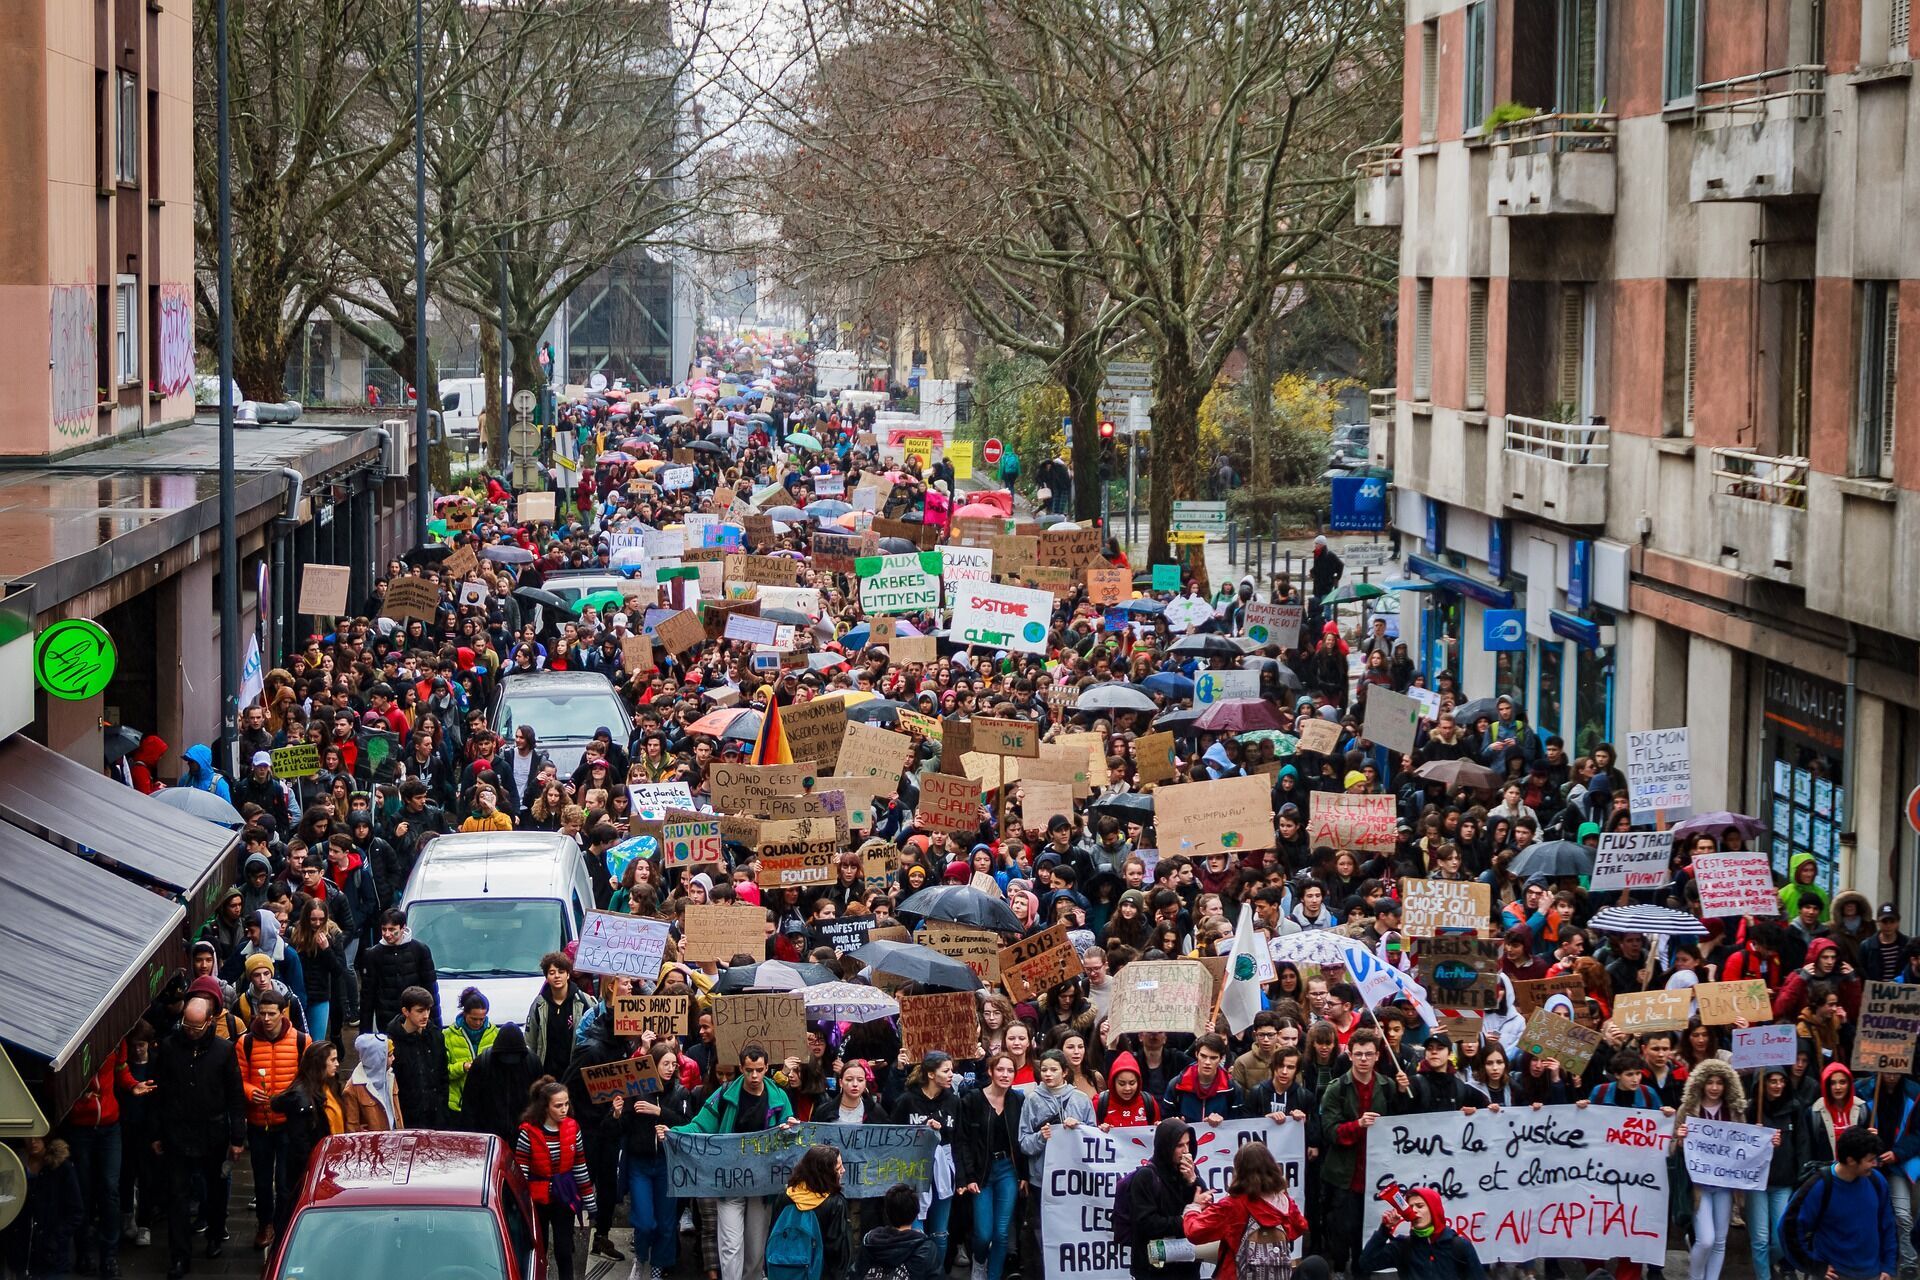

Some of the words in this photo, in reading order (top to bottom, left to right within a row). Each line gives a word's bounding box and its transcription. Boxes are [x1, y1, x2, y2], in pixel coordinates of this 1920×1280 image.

[1046, 544, 1066, 556] LES
[747, 559, 781, 571] PHOQUE
[784, 561, 794, 572] LE
[884, 554, 917, 569] AUX
[1050, 558, 1069, 568] PAS
[868, 574, 925, 590] ARBRES
[862, 590, 936, 608] CITOYENS
[971, 596, 1029, 617] SYSTEME
[1247, 603, 1276, 616] CLIMATE
[1277, 606, 1302, 618] CHANGE
[1246, 614, 1265, 625] MADE
[1268, 616, 1280, 626] ME
[1281, 618, 1290, 627] DO
[1002, 734, 1024, 748] DIE
[1630, 733, 1650, 748] DIS
[1656, 732, 1686, 744] MON
[274, 750, 288, 760] PAS
[290, 747, 316, 758] BESOIN
[1629, 764, 1645, 776] TA
[1646, 760, 1690, 775] PLANETE
[716, 770, 760, 788] QUAND
[770, 774, 799, 785] C'EST
[924, 778, 944, 795] ON
[950, 783, 968, 797] EST
[1630, 777, 1642, 786] TU
[1644, 776, 1653, 784] LA
[634, 786, 651, 798] Ta
[654, 786, 686, 799] planète
[744, 786, 778, 796] FONDU
[1636, 784, 1668, 796] BLEUE
[720, 794, 754, 809] C'EST
[772, 800, 796, 814] PAS
[804, 802, 820, 813] DE
[938, 797, 976, 816] CHAUD
[1654, 794, 1691, 807] CUITE?
[945, 814, 956, 827] LE
[664, 822, 719, 839] SAUVONS
[1315, 822, 1353, 848] AU
[762, 842, 809, 857] QUAND
[810, 840, 836, 854] C'EST
[1602, 834, 1637, 850] PLUS
[1642, 833, 1672, 847] TARD
[666, 838, 721, 865] NOUS!
[1596, 852, 1612, 864] JE
[1616, 850, 1670, 862] VOUDRAIS
[761, 857, 804, 870] FONDUE
[804, 853, 834, 866] C'EST
[1624, 871, 1664, 886] VIVANT
[1698, 871, 1726, 880] FACILE
[1728, 868, 1738, 877] DE
[1407, 880, 1424, 896] LA
[1426, 880, 1470, 900] SEULE
[1404, 896, 1446, 912] CHOSE
[1448, 899, 1476, 916] QUI
[612, 920, 628, 934] ÇA
[637, 924, 650, 934] VA
[822, 918, 876, 934] MANIFESTATION
[1406, 910, 1438, 925] DOIT
[1442, 912, 1490, 930] FONDRE
[606, 934, 664, 955] CHAUFFER
[832, 934, 850, 944] POUR
[850, 933, 860, 943] LE
[583, 942, 662, 976] RÉAGISSEZ
[1872, 983, 1917, 1000] HAUT
[618, 998, 647, 1014] TOUS
[648, 998, 672, 1014] DANS
[675, 999, 688, 1016] LA
[1868, 1002, 1886, 1013] LES
[615, 1014, 642, 1033] MÊME
[642, 1015, 680, 1035] MERDE
[746, 1024, 771, 1038] ON
[587, 1062, 631, 1080] ARRÊTE
[635, 1059, 651, 1072] DE
[588, 1078, 624, 1092] NIQUER
[625, 1078, 658, 1096] MER
[670, 1134, 722, 1156] VOUS
[838, 1127, 926, 1150] VIEILLESSE
[1392, 1126, 1454, 1156] Pour
[1462, 1122, 1488, 1152] la
[1506, 1114, 1588, 1158] justice
[1606, 1127, 1673, 1150] PARTOUT
[1688, 1122, 1701, 1134] CE
[1702, 1124, 1723, 1139] QUI
[1726, 1130, 1760, 1148] RISQUE
[1081, 1137, 1116, 1164] ILS
[1687, 1140, 1730, 1158] D'ARRIVER
[1736, 1148, 1746, 1160] A
[671, 1166, 698, 1188] ON
[714, 1168, 754, 1188] AURA
[864, 1158, 929, 1186] CHANCE
[1478, 1161, 1510, 1191] et
[1518, 1158, 1660, 1204] climatique
[1496, 1207, 1532, 1244] AU
[1538, 1194, 1659, 1240] CAPITAL
[1060, 1241, 1132, 1272] ARBRE
